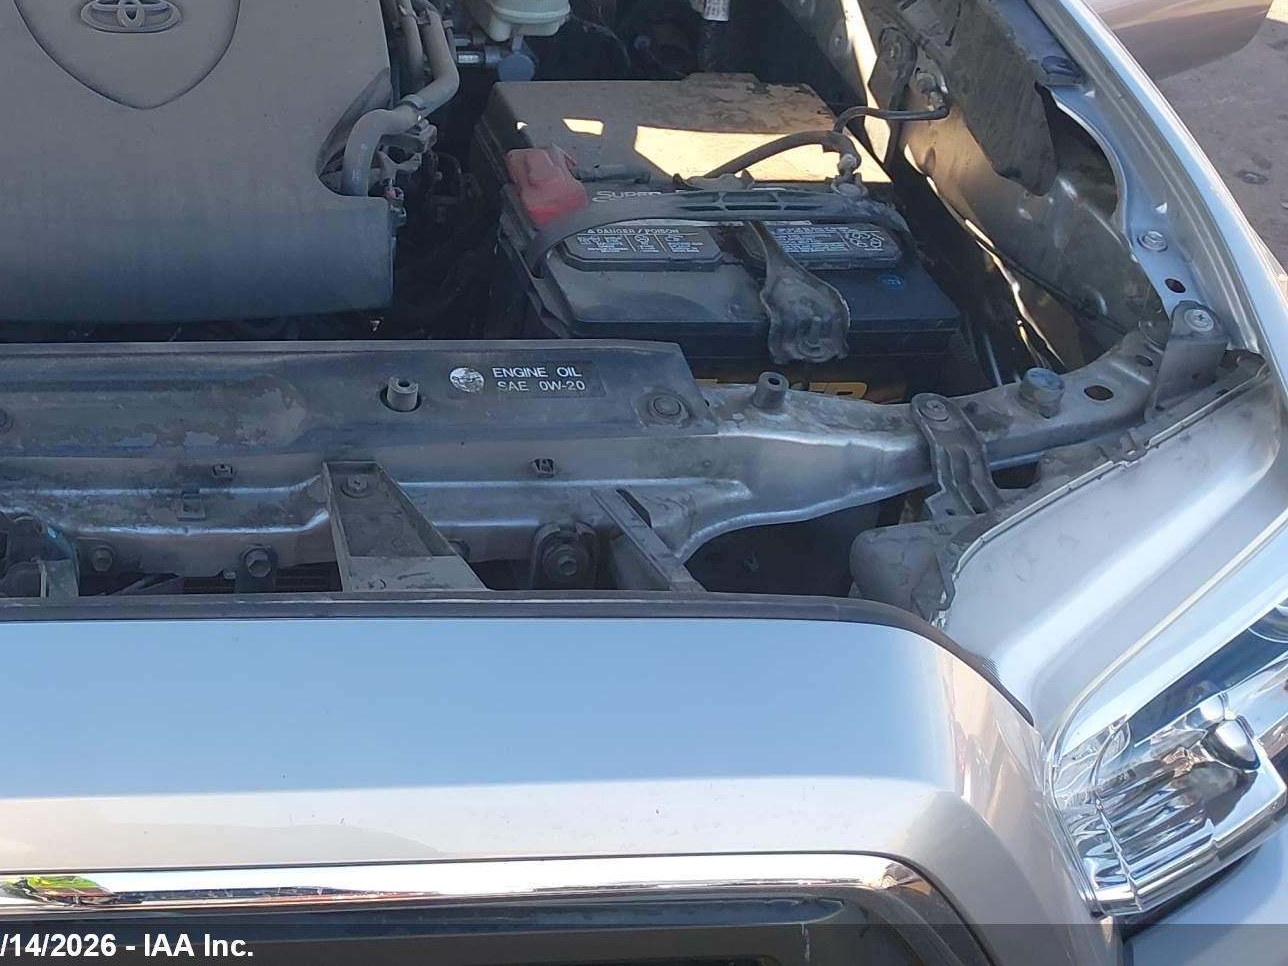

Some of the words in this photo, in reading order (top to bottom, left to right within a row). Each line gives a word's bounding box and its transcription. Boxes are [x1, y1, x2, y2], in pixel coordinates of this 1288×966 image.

[492, 367, 549, 378] ENGINE
[556, 367, 583, 378] OIL
[497, 381, 530, 392] SAE
[539, 381, 586, 392] 0W-20
